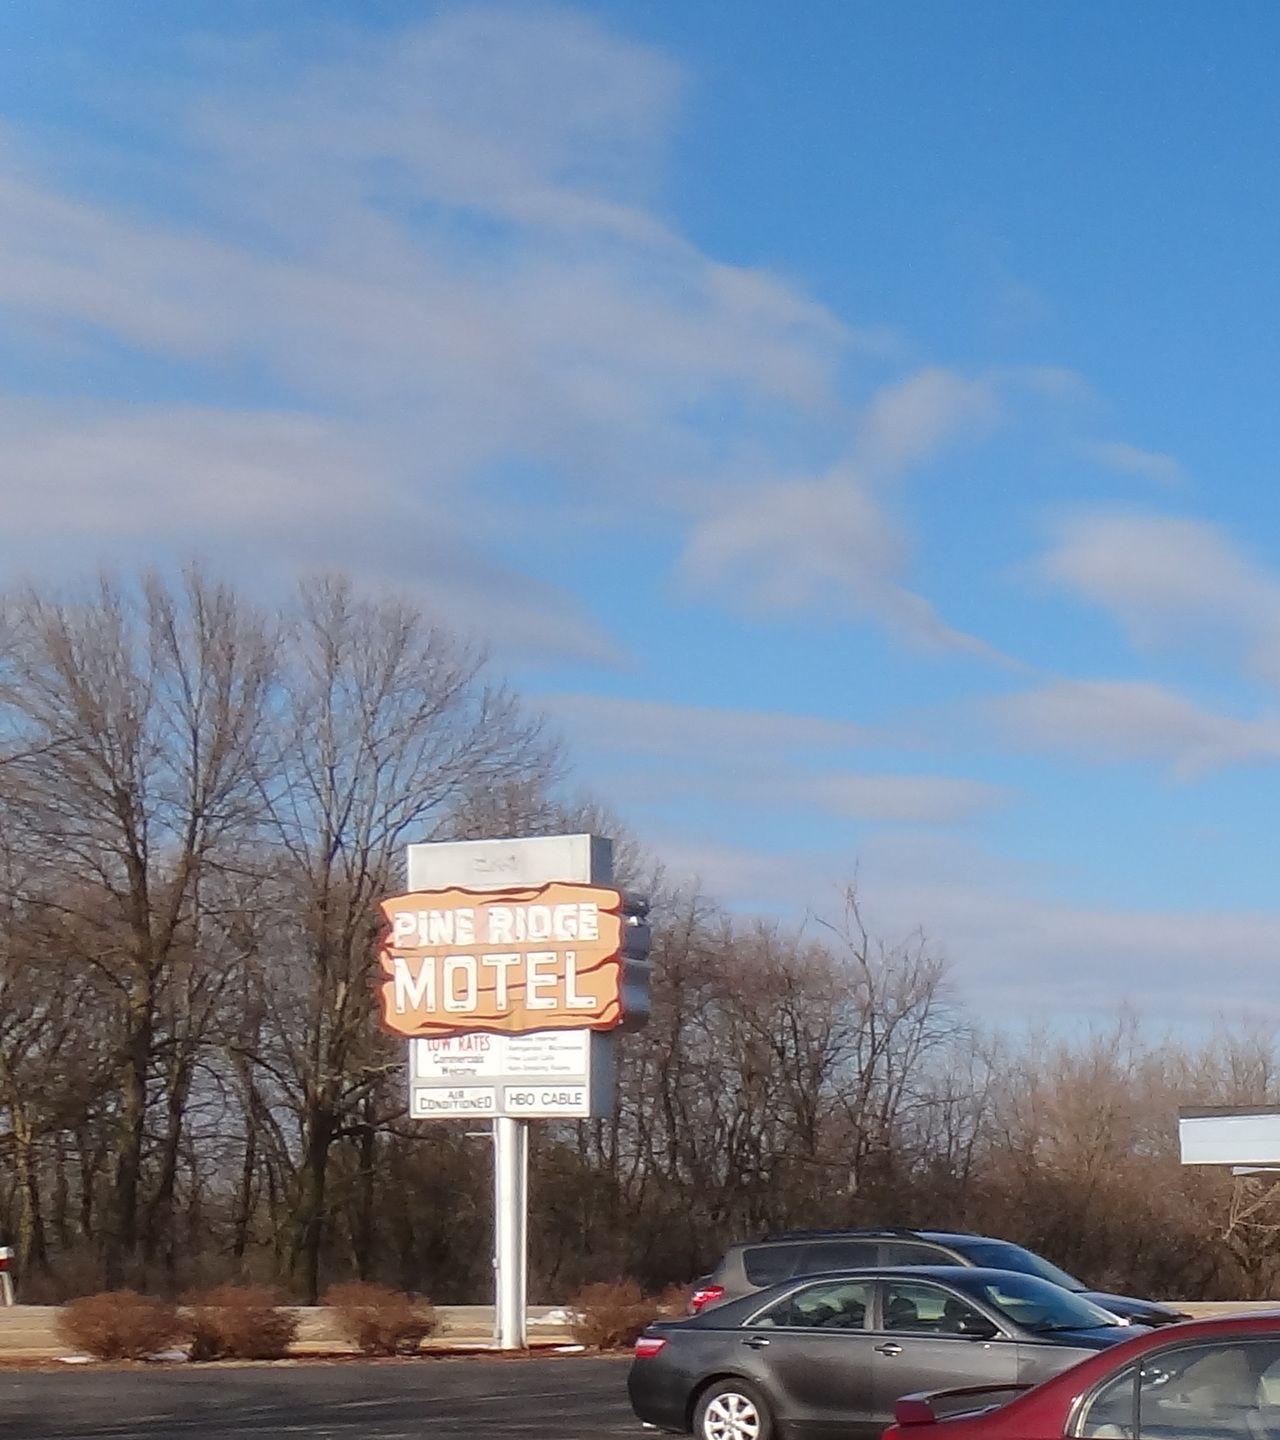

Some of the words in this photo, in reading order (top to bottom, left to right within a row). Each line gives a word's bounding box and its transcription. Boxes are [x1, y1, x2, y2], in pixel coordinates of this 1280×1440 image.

[394, 908, 474, 947] PINE
[488, 903, 599, 944] RIDGE
[394, 951, 597, 1014] MOTEL
[459, 1034, 490, 1051] RATES
[448, 1090, 465, 1099] AIR
[510, 1093, 535, 1105] HBO
[541, 1092, 582, 1105] CABLE
[420, 1096, 492, 1110] CONDITIONED
